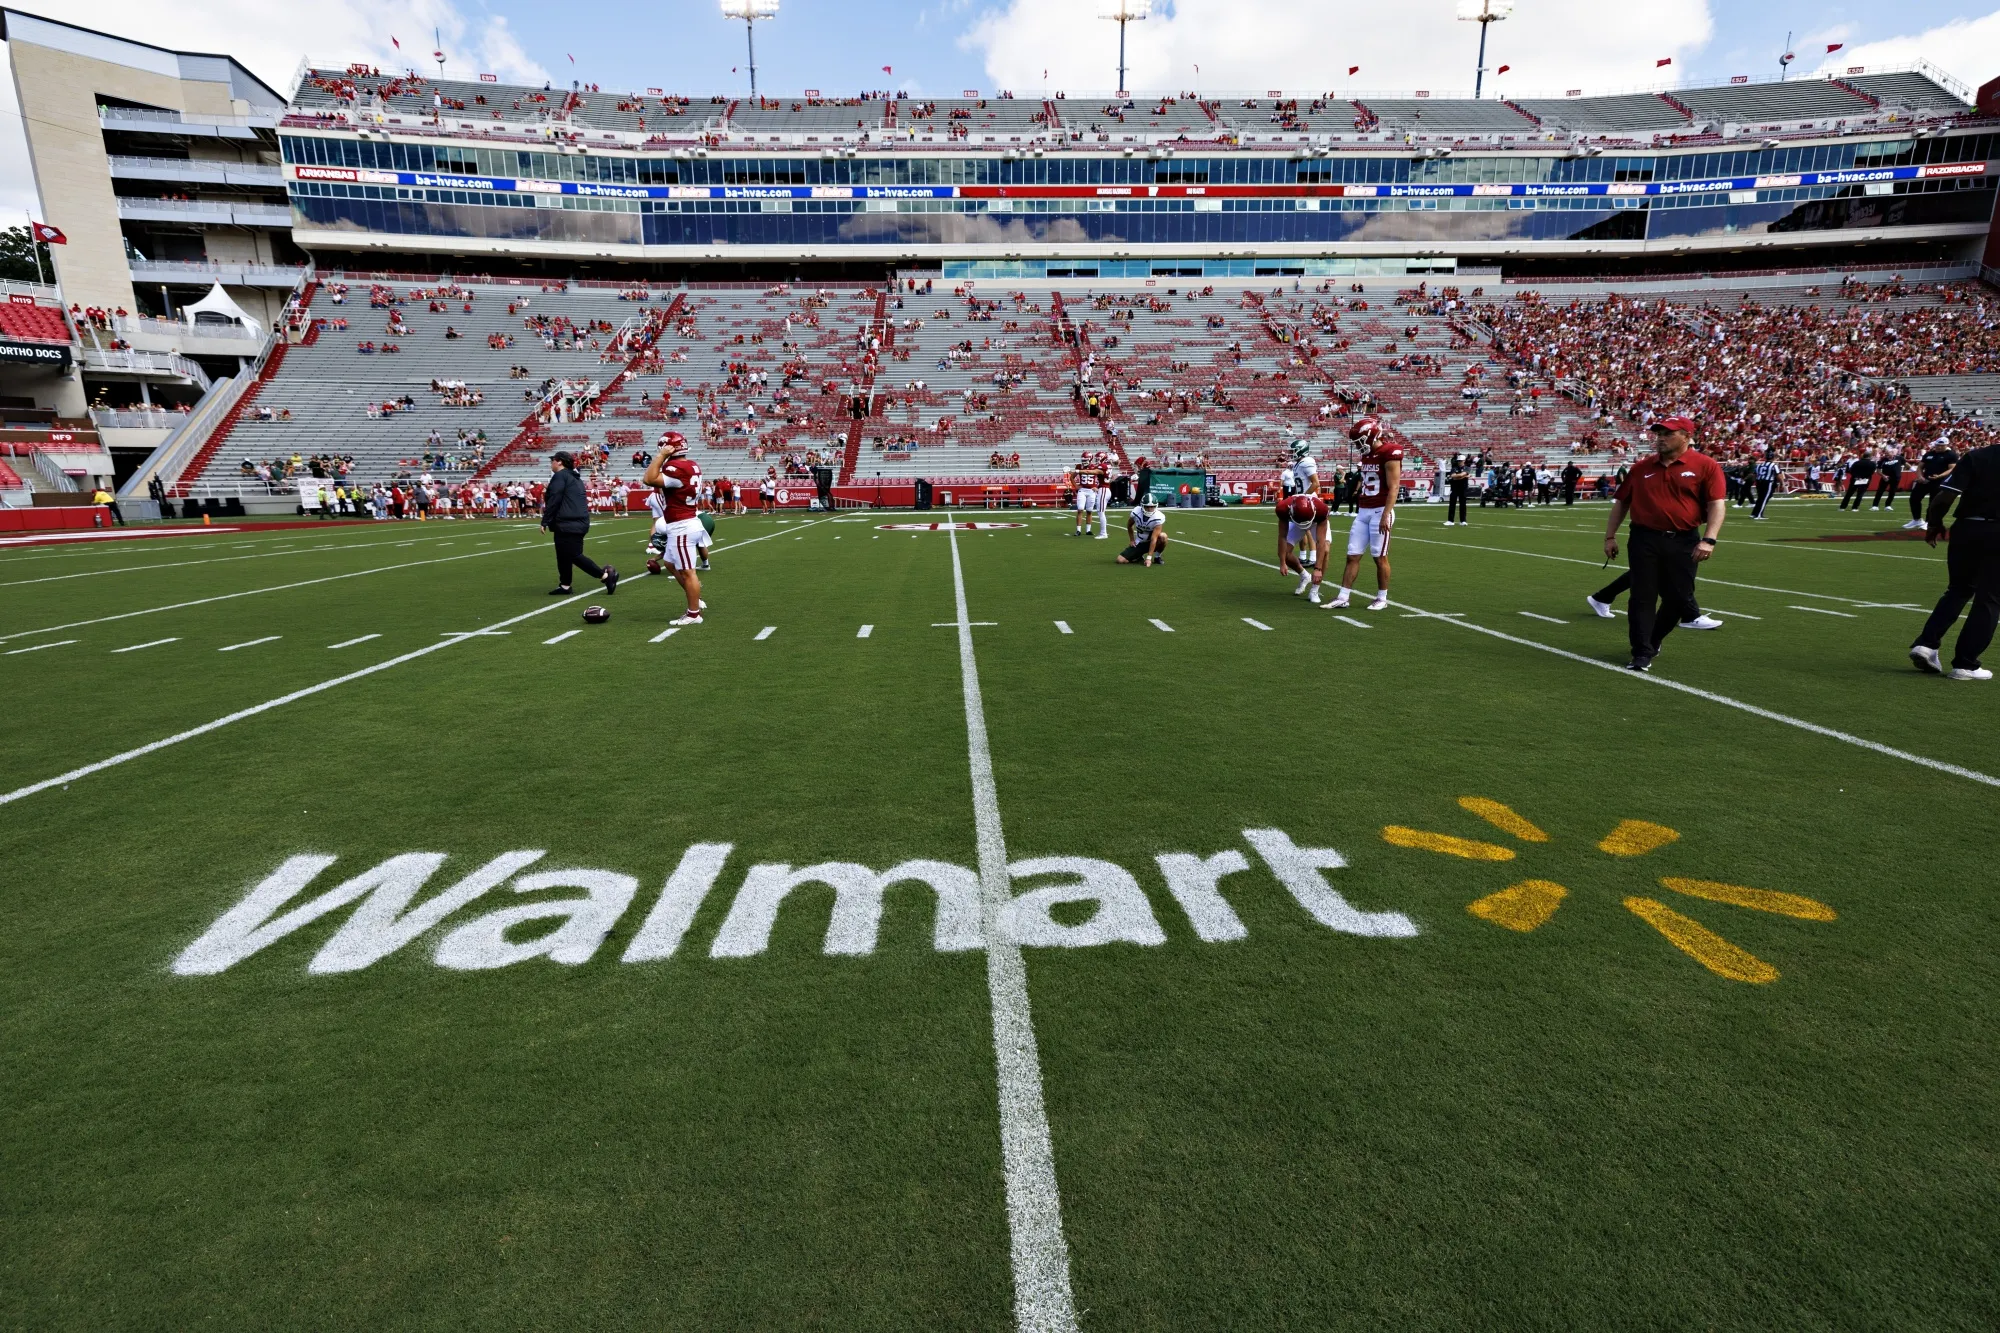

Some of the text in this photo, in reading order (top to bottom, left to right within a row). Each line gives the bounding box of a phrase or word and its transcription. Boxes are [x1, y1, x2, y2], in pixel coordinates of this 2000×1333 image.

[298, 168, 356, 181] ARKANSAS
[1817, 170, 1894, 184] ba-hvac.com
[1927, 165, 1985, 177] RAZORBACKS
[415, 174, 494, 190] ba-hvac.com
[1659, 180, 1733, 195] ba-hvac.com
[577, 184, 649, 198] ba-hvac.com
[724, 187, 792, 198] ba-hvac.com
[866, 187, 934, 198] ba-hvac.com
[1390, 186, 1454, 197] ba-hvac.com
[1525, 184, 1589, 196] ba-hvac.com
[12, 296, 32, 305] N119
[0, 346, 62, 359] ORTHO DOCS
[168, 826, 1420, 978] Walmart
